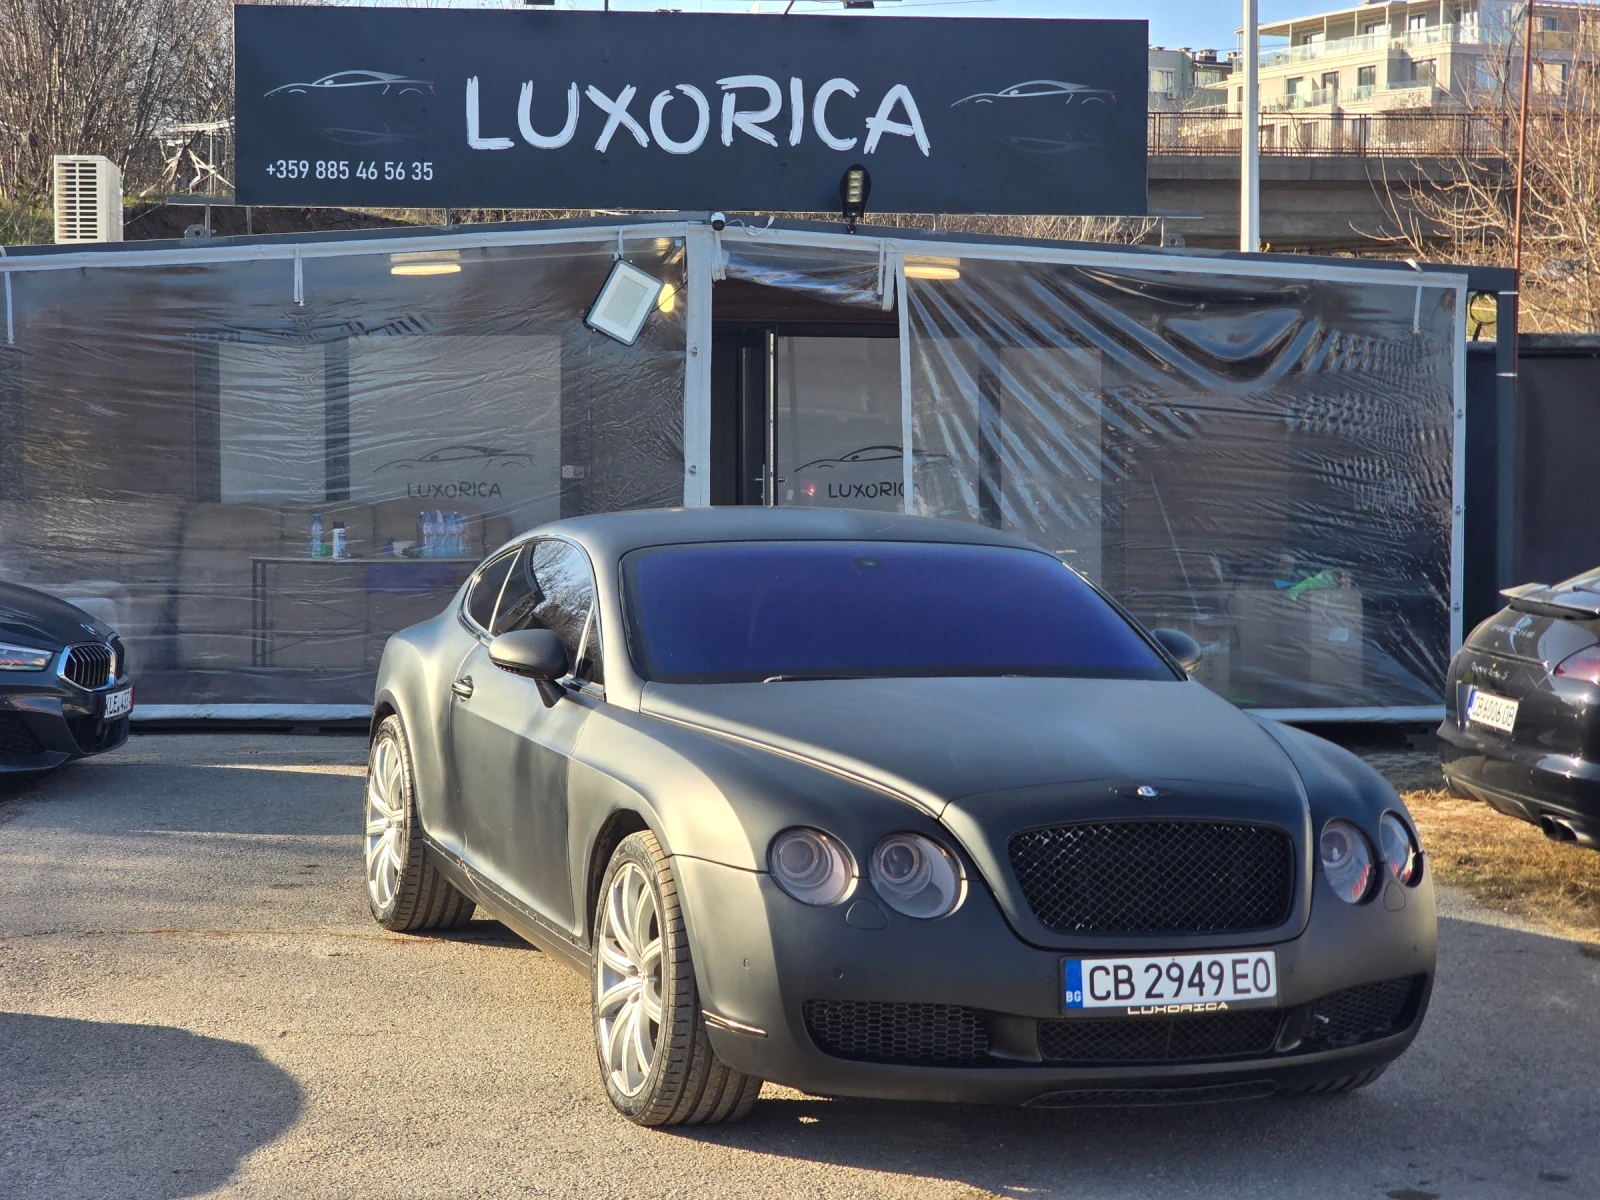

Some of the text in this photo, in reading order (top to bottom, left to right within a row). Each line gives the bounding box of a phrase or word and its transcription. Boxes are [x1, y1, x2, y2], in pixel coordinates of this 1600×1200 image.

[465, 74, 930, 156] LUXORICA
[266, 160, 433, 181] +359 885 46 56 35
[407, 482, 502, 498] LUXORICA
[1089, 965, 1136, 1001] CB
[1144, 959, 1225, 998] 2949
[1066, 991, 1081, 1003] BG
[1127, 1002, 1228, 1015] LUXORICA
